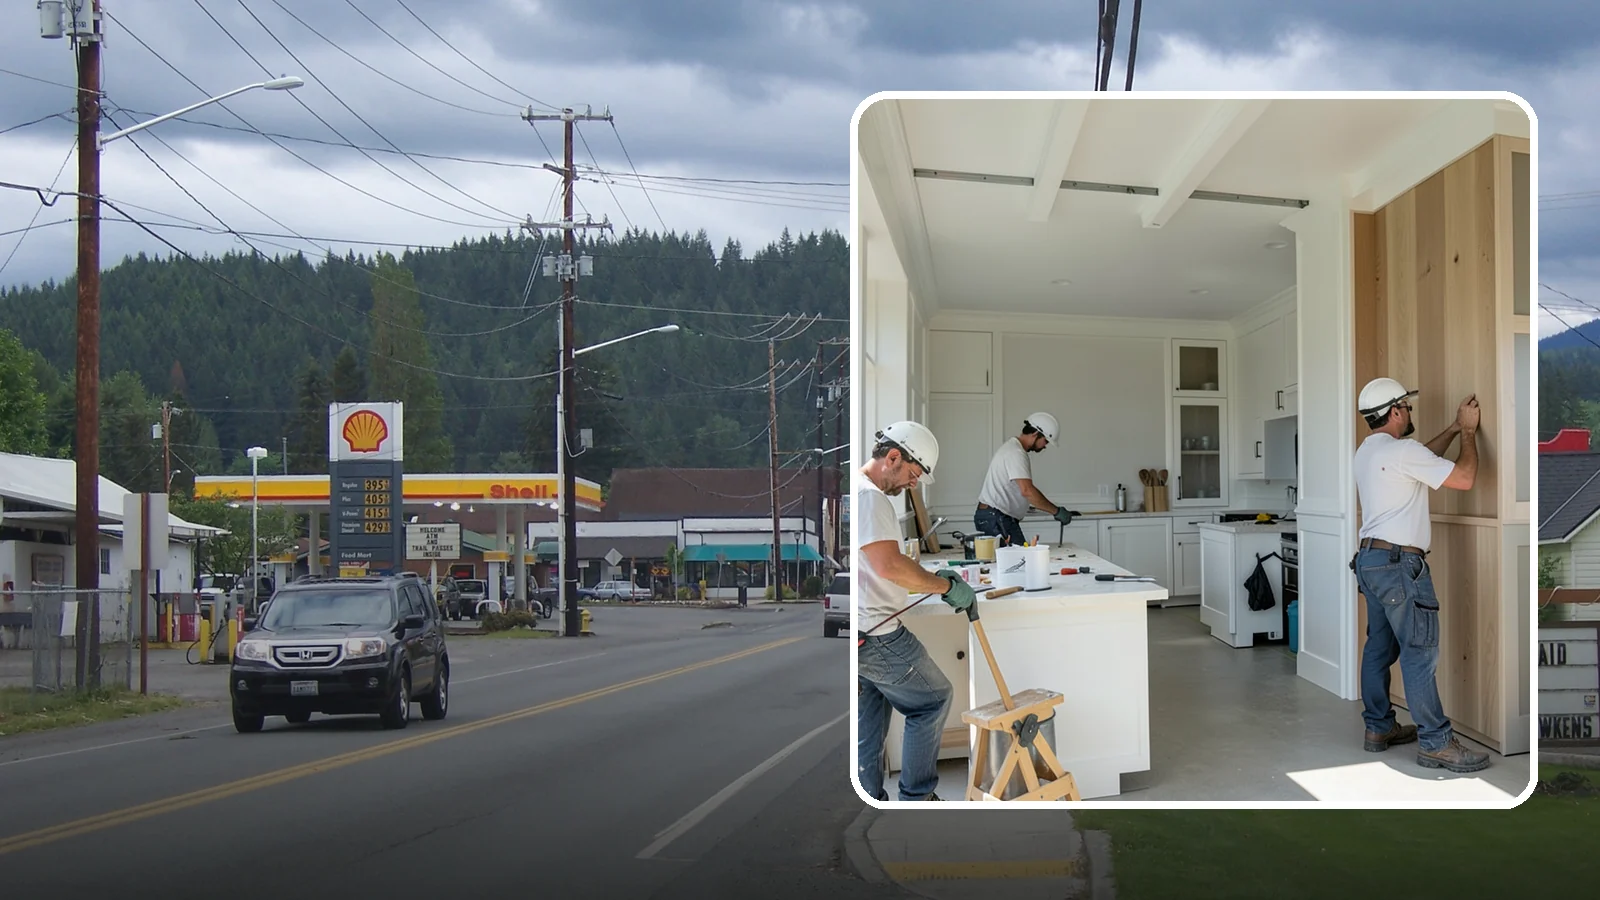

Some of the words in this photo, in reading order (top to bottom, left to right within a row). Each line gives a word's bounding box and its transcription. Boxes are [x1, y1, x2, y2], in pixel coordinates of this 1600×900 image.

[366, 480, 384, 490] 395
[490, 484, 547, 499] Shell
[366, 494, 384, 504] 405
[366, 508, 384, 518] 415
[366, 522, 384, 532] 429
